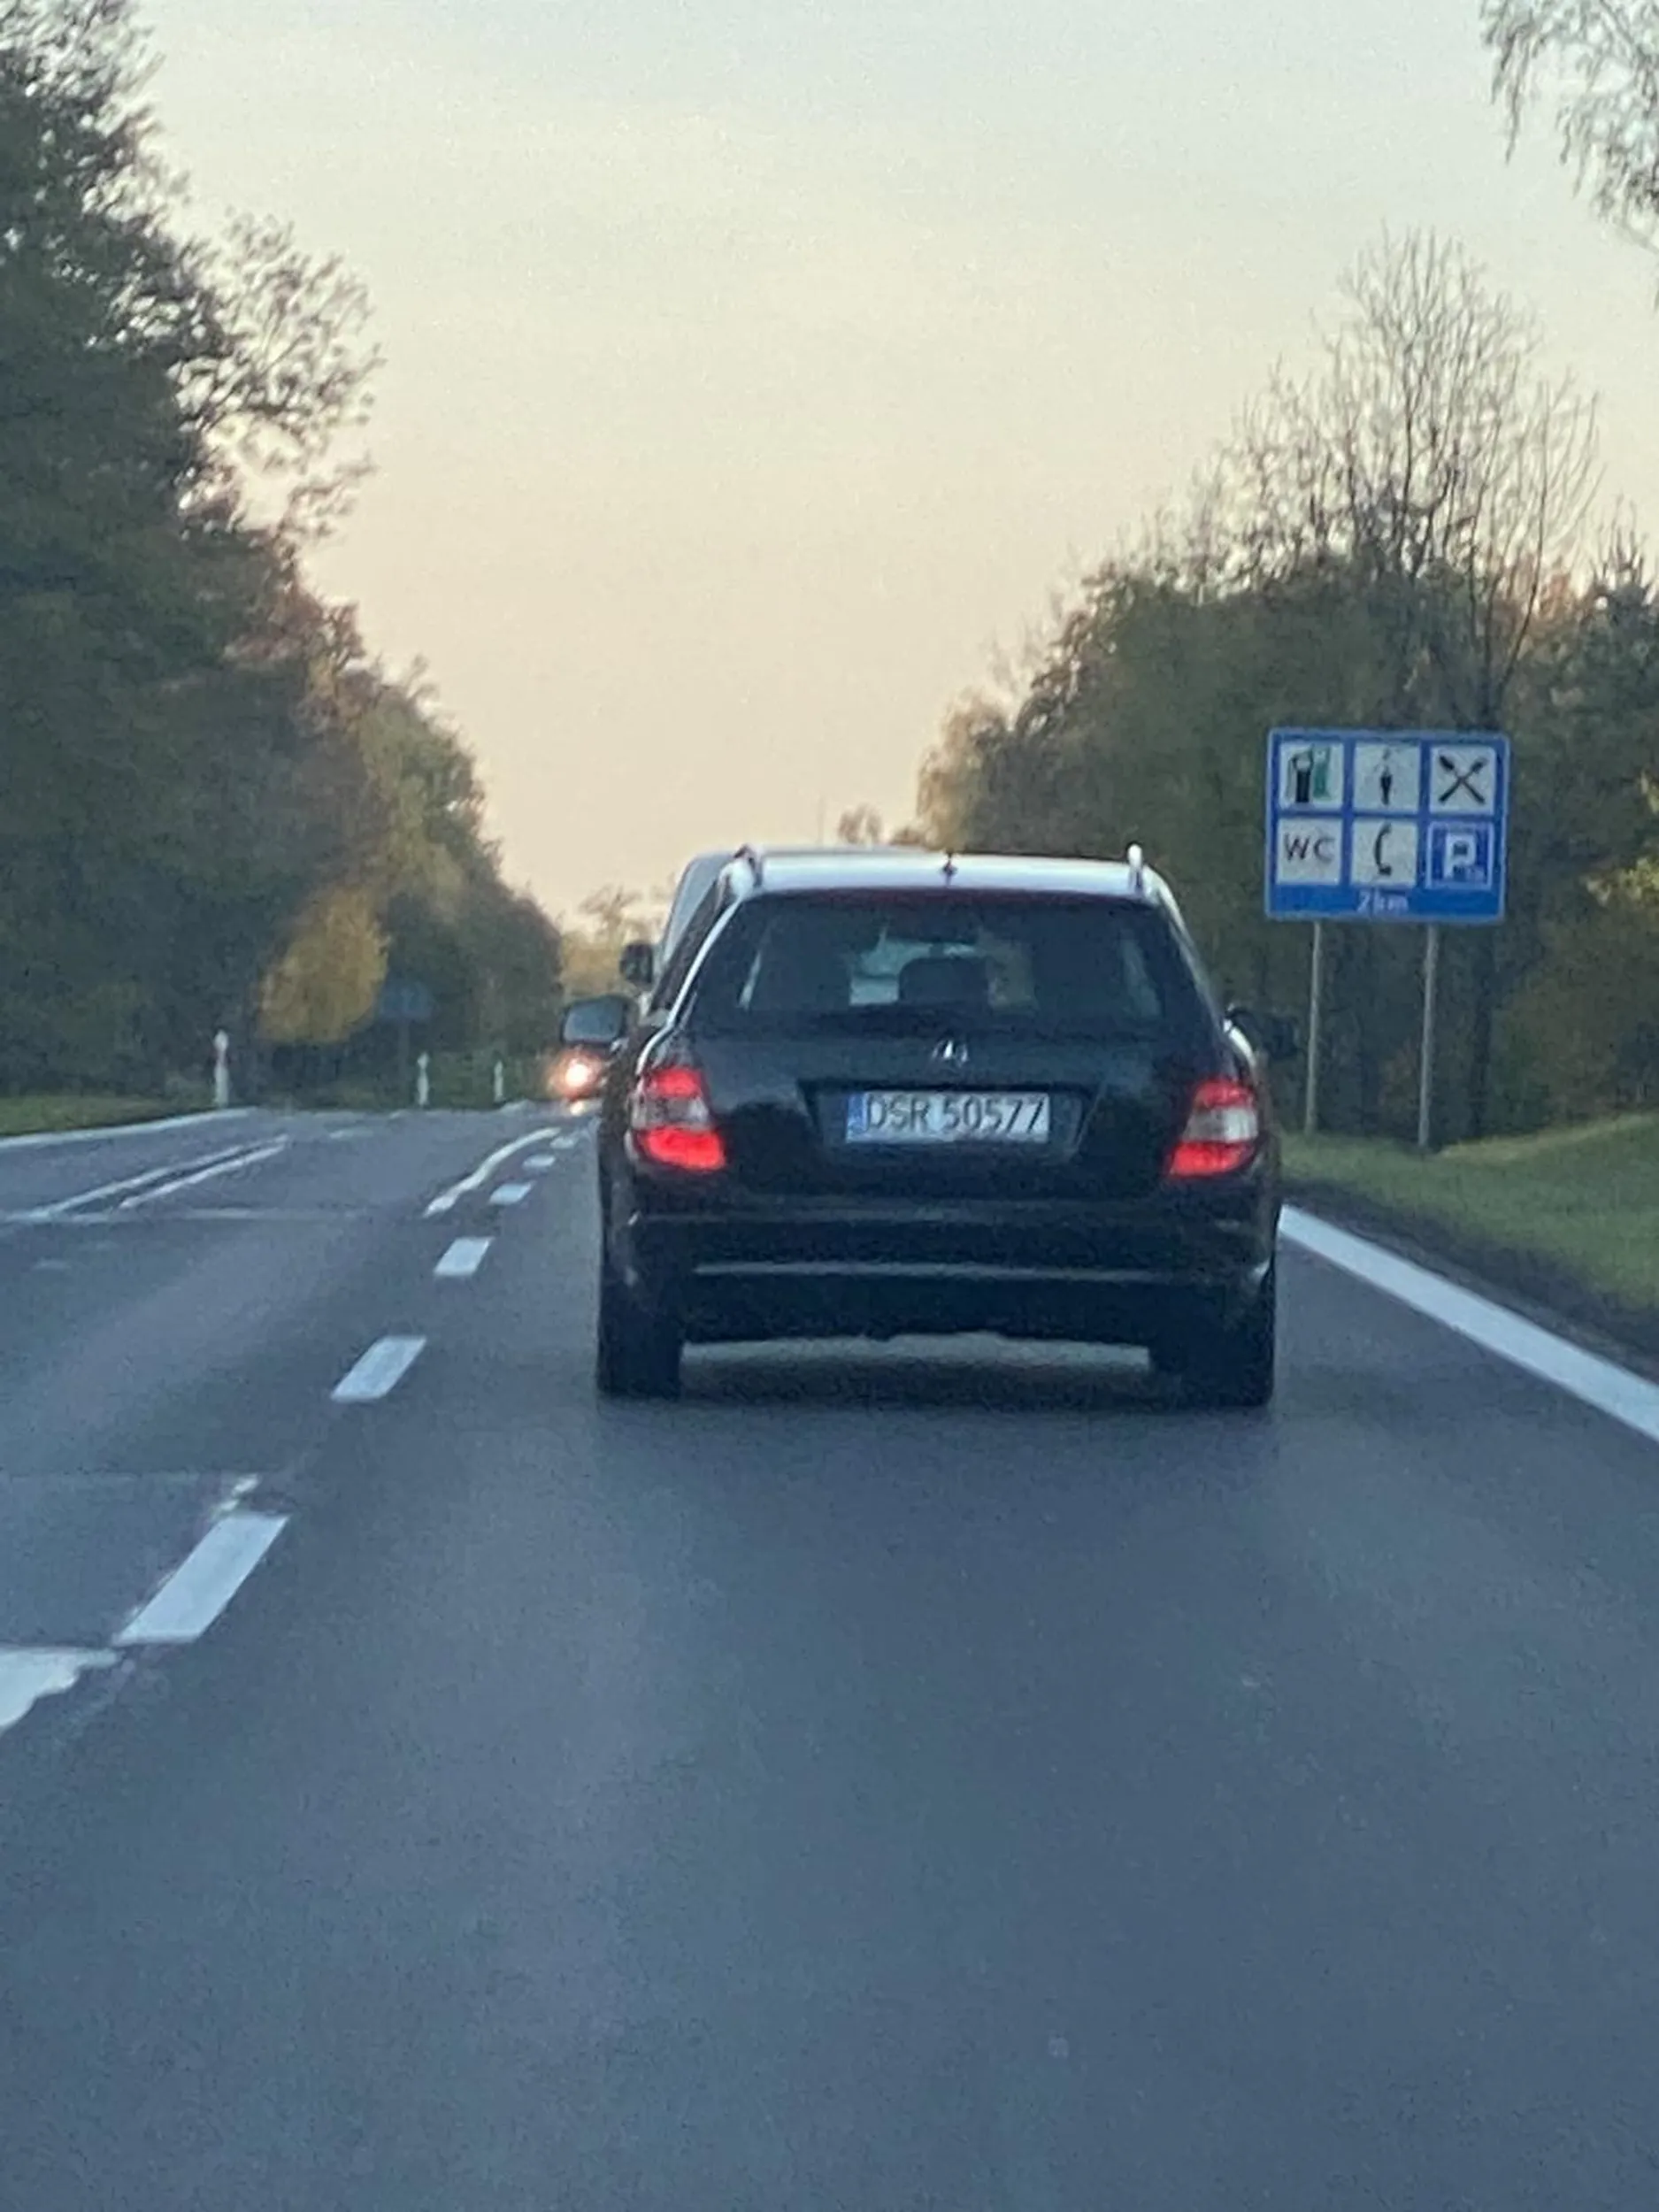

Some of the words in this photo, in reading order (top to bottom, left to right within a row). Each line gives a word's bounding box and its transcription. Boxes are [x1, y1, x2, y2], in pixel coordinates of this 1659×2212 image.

[1284, 834, 1333, 862] WC
[865, 1092, 929, 1133] DSR
[941, 1093, 1048, 1134] 50577
